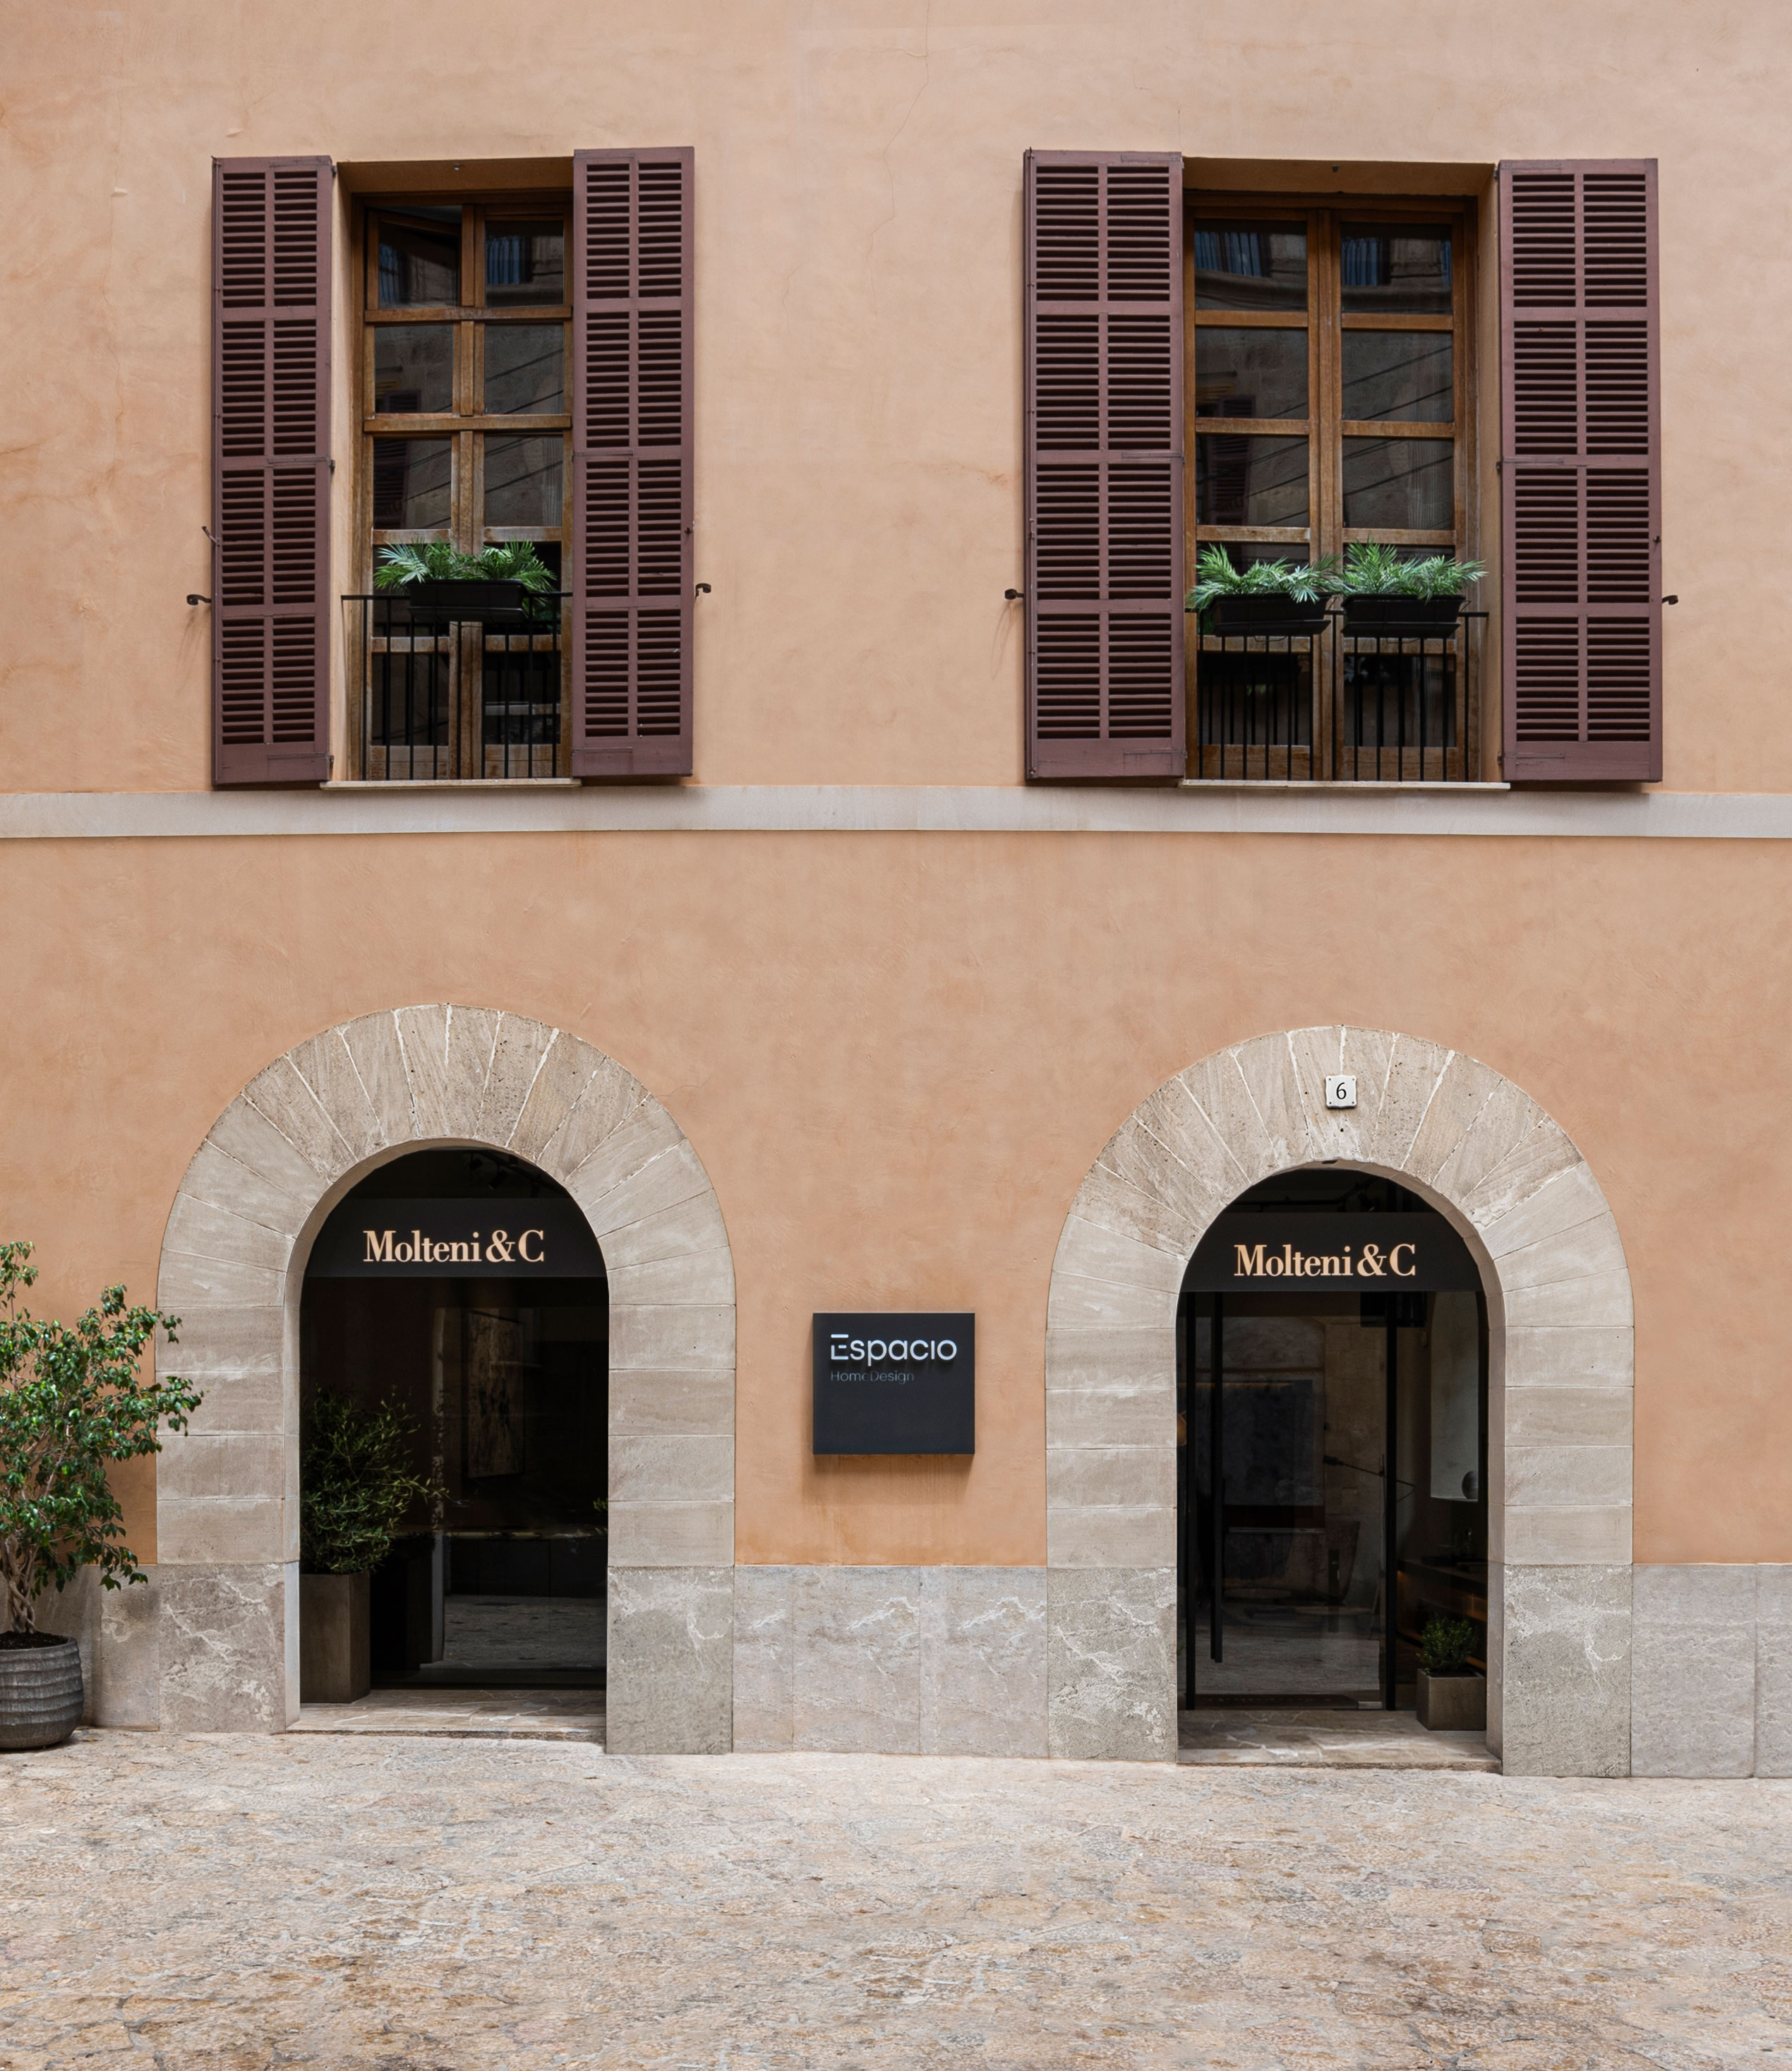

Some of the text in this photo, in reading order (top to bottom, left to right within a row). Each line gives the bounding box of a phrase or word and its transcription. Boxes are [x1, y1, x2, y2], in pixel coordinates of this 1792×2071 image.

[1336, 1081, 1347, 1100] 6
[363, 1229, 544, 1263] Molteni&C
[1234, 1243, 1416, 1277] Molteni&C
[830, 1333, 958, 1367] Espacio
